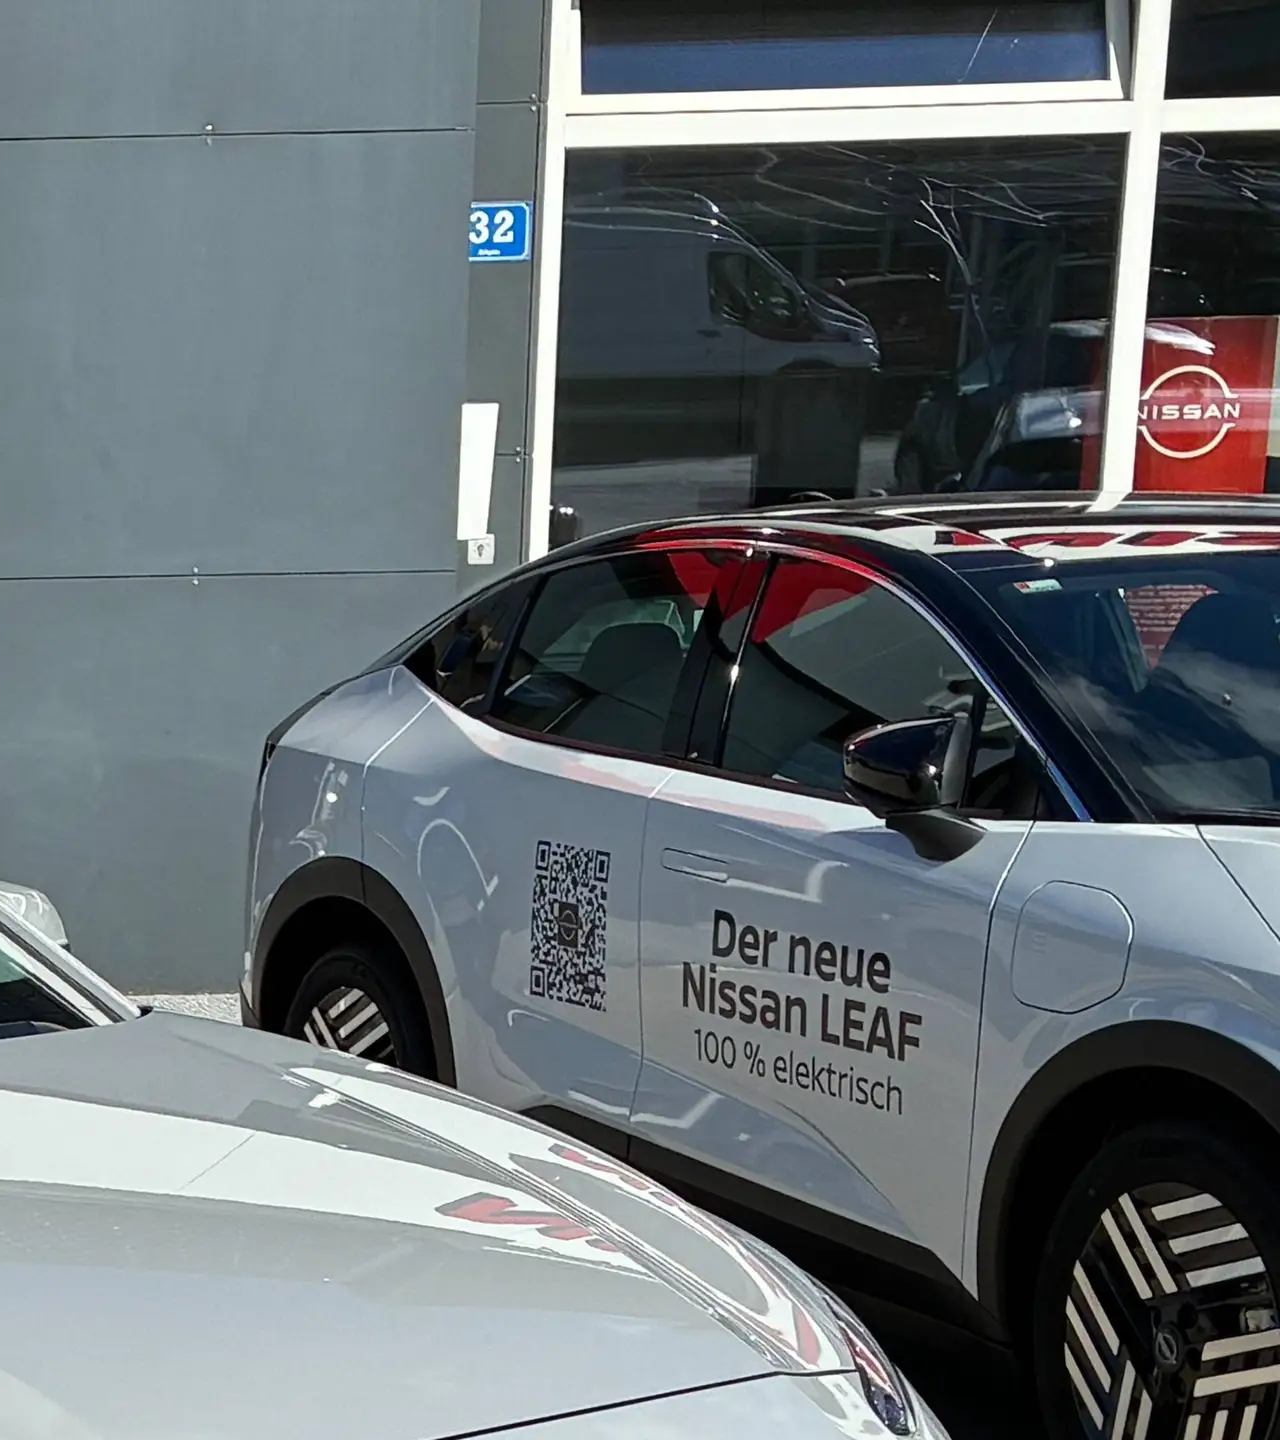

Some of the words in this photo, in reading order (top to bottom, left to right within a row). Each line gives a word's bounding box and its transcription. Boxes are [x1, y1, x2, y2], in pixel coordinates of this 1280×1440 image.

[468, 209, 514, 244] 32
[712, 908, 778, 968] Der
[787, 934, 891, 994] neue
[682, 961, 807, 1038] Nissan
[821, 993, 923, 1062] LEAF
[694, 1028, 737, 1069] 100
[743, 1040, 766, 1078] %
[773, 1050, 903, 1115] elektrisch
